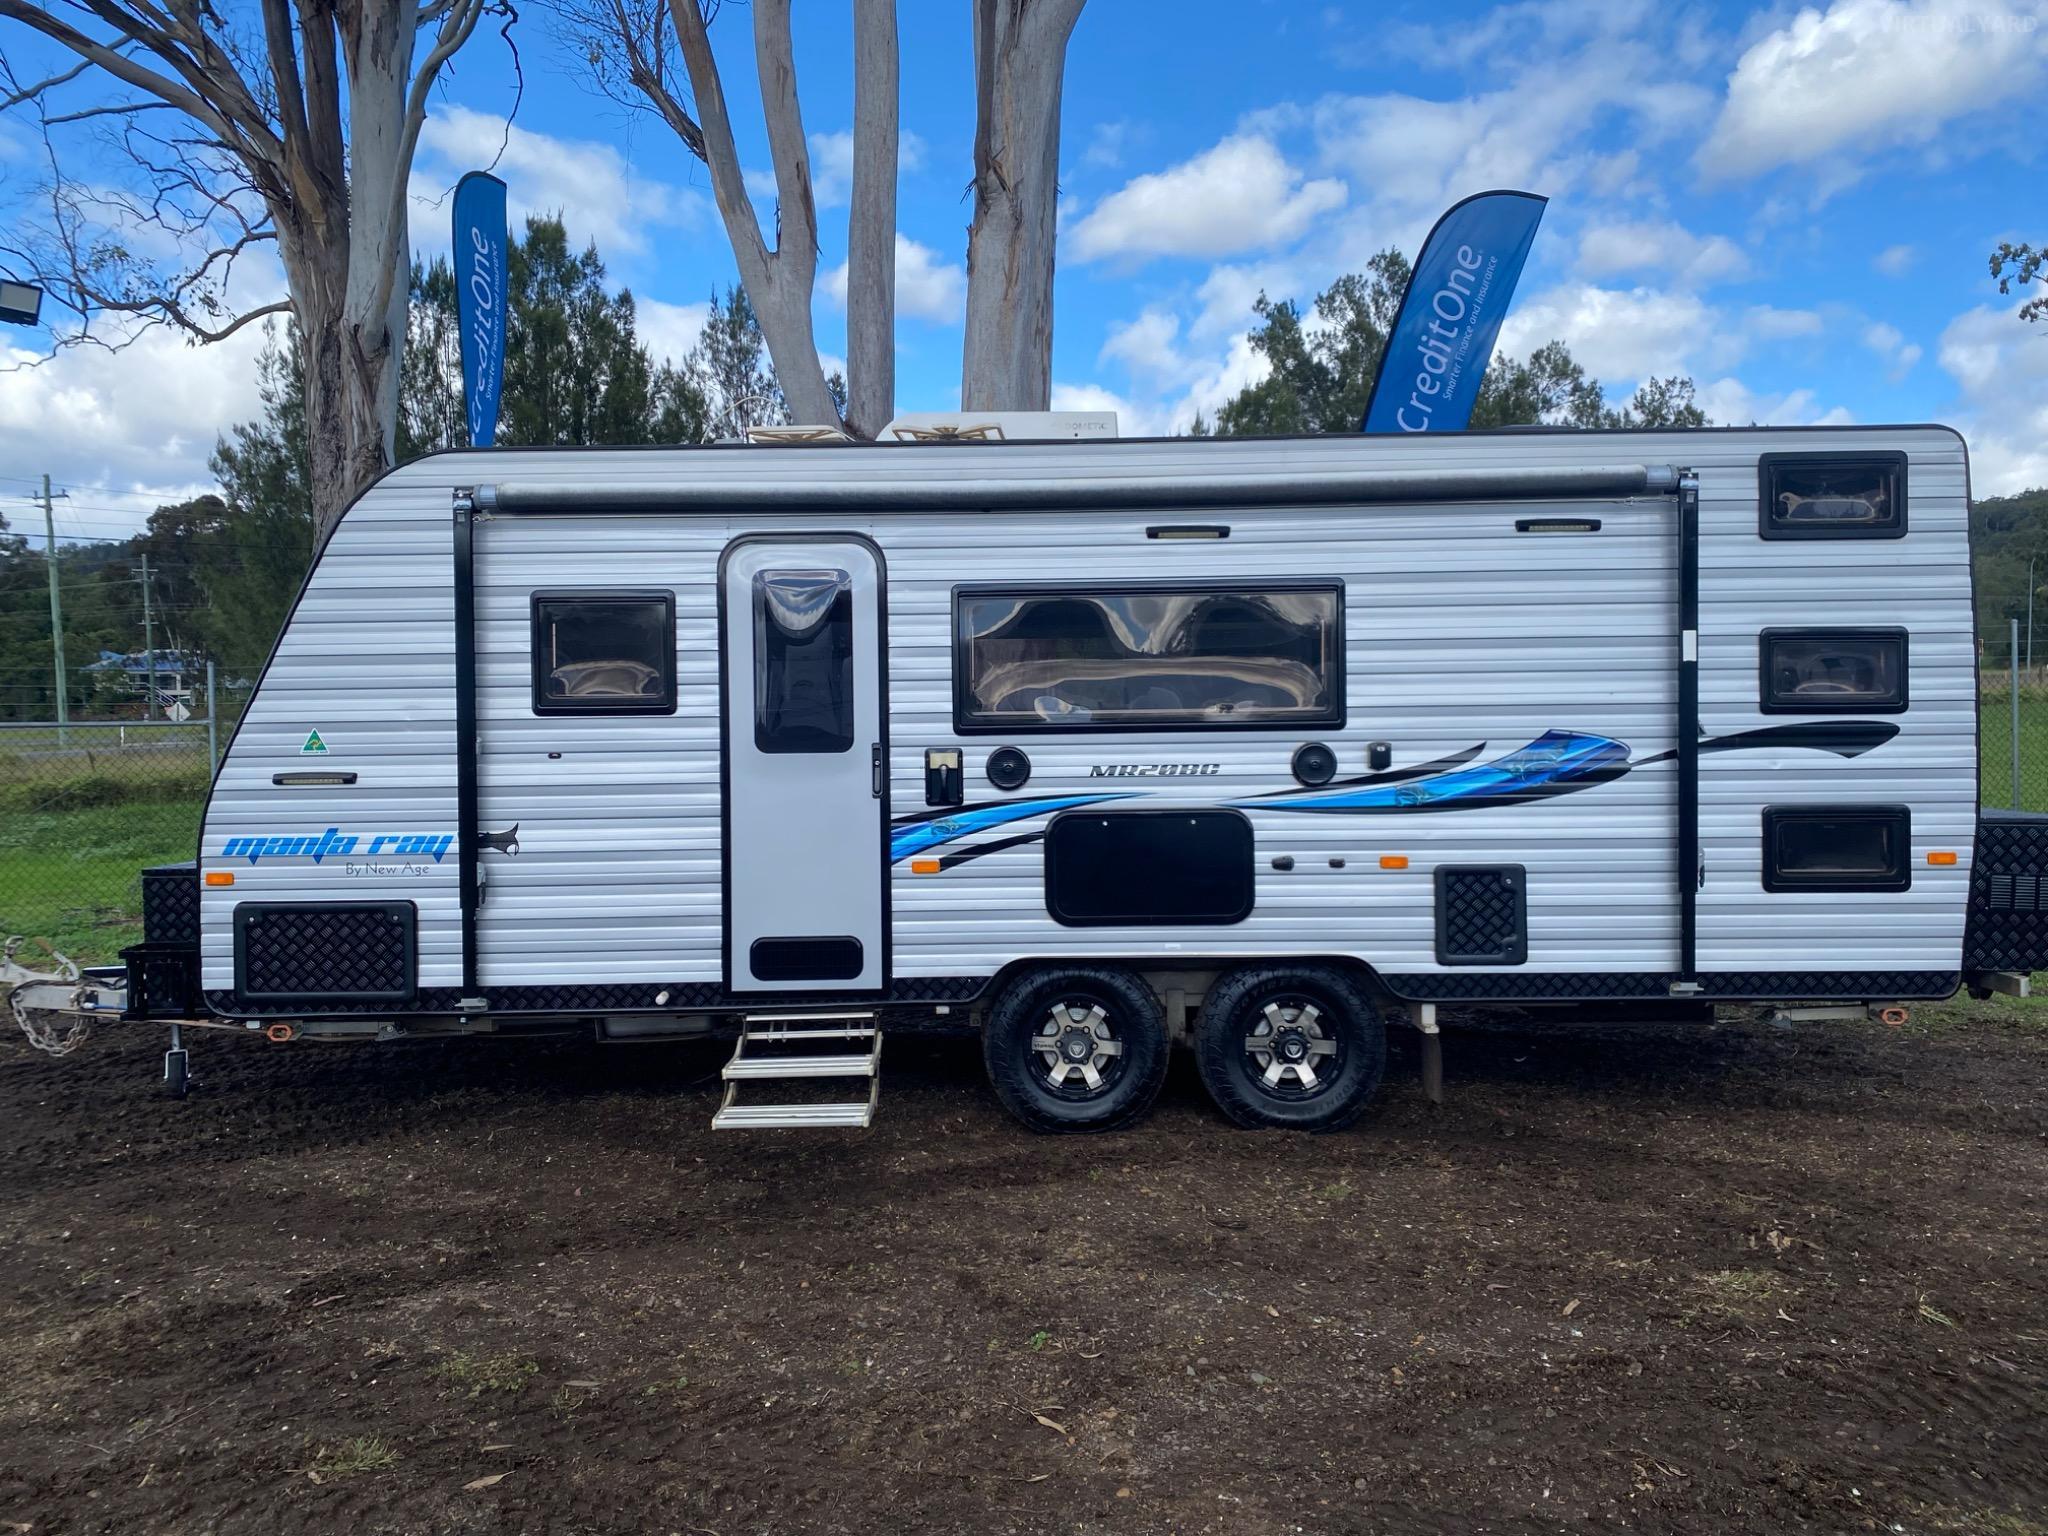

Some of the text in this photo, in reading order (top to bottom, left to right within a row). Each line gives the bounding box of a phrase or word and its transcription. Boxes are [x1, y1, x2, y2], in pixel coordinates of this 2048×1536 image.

[471, 226, 492, 434] CreditOne
[1396, 244, 1482, 433] CreditOne
[1442, 255, 1498, 401] Smarter Finance and Insurance
[222, 827, 454, 866] manta ray
[345, 861, 430, 877] By New Age
